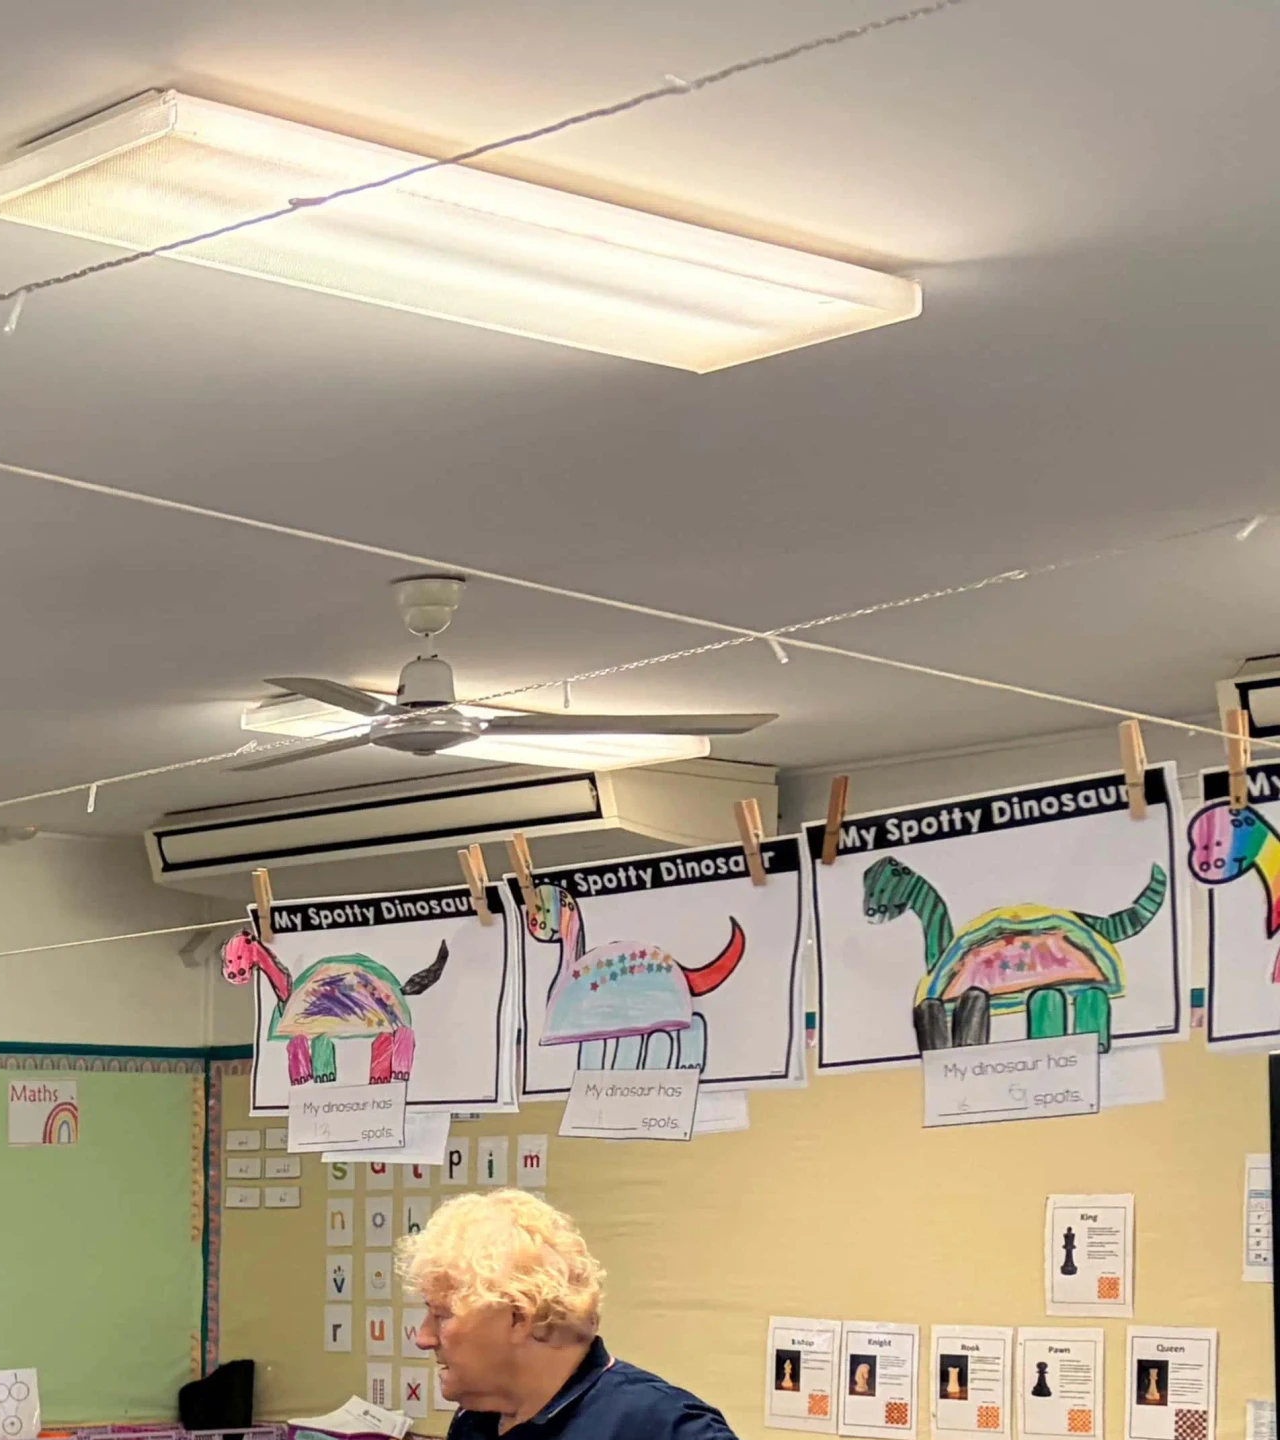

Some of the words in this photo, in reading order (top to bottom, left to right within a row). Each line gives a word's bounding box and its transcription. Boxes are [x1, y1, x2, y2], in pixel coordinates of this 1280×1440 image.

[839, 825, 878, 850] My
[886, 808, 983, 843] Spotty
[574, 865, 653, 895] Spotty
[659, 851, 776, 880] Dinosar
[274, 910, 302, 931] My
[308, 904, 375, 928] Spotty
[944, 1063, 967, 1081] My
[972, 1058, 1042, 1076] dinosaur
[1047, 1054, 1078, 1069] has
[11, 1084, 58, 1103] Maths
[585, 1084, 603, 1099] My
[606, 1083, 654, 1097] dinosaur
[658, 1085, 682, 1097] has
[303, 1102, 320, 1115] My
[323, 1100, 368, 1113] dinosaur
[371, 1098, 393, 1110] has
[332, 1160, 347, 1181] s
[449, 1150, 462, 1179] p
[487, 1152, 495, 1178] i
[523, 1153, 540, 1168] m
[331, 1210, 346, 1230] n
[372, 1212, 385, 1228] o
[1080, 1213, 1098, 1223] King
[332, 1323, 342, 1343] r
[370, 1320, 385, 1341] u
[868, 1338, 892, 1348] Knight
[961, 1343, 980, 1352] Rook
[1048, 1346, 1071, 1354] Pawn
[1156, 1344, 1185, 1353] Queen
